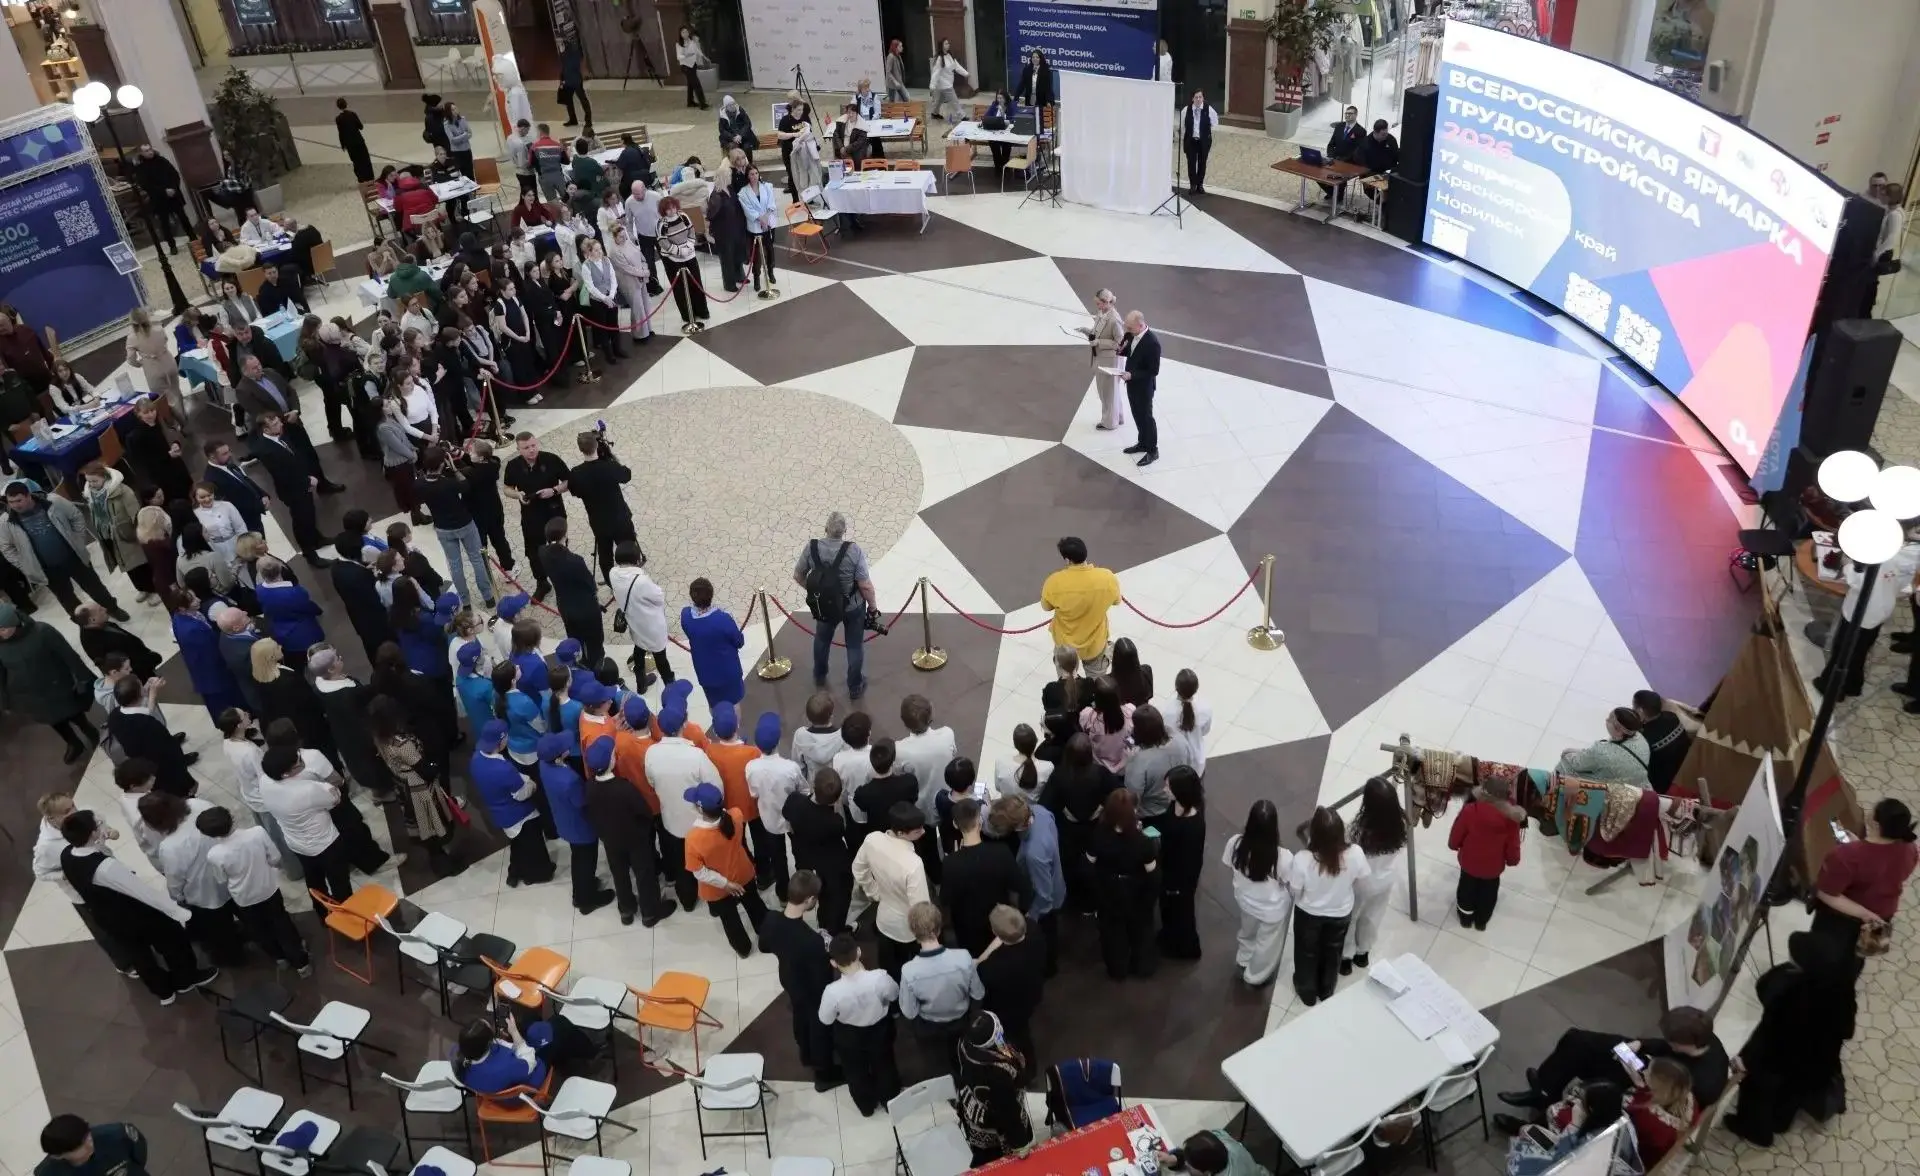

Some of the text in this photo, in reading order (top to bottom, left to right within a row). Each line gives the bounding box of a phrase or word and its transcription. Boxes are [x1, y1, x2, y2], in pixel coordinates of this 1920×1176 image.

[1019, 20, 1107, 32] ВСЕРОССИЙСКАЯ ЯРМАРКА
[1019, 29, 1082, 40] ТРУДОУСТРОЙСТВА
[1053, 59, 1125, 72] возможностей»
[1058, 48, 1095, 58] России.
[1443, 121, 1514, 162] 2026
[1446, 96, 1702, 228] ТРУДОУСТРОЙСТВА
[1449, 69, 1803, 266] ВСЕРОССИЙСКАЯ ЯРМАРКА
[1436, 190, 1524, 240] Норильск
[1575, 230, 1618, 263] край
